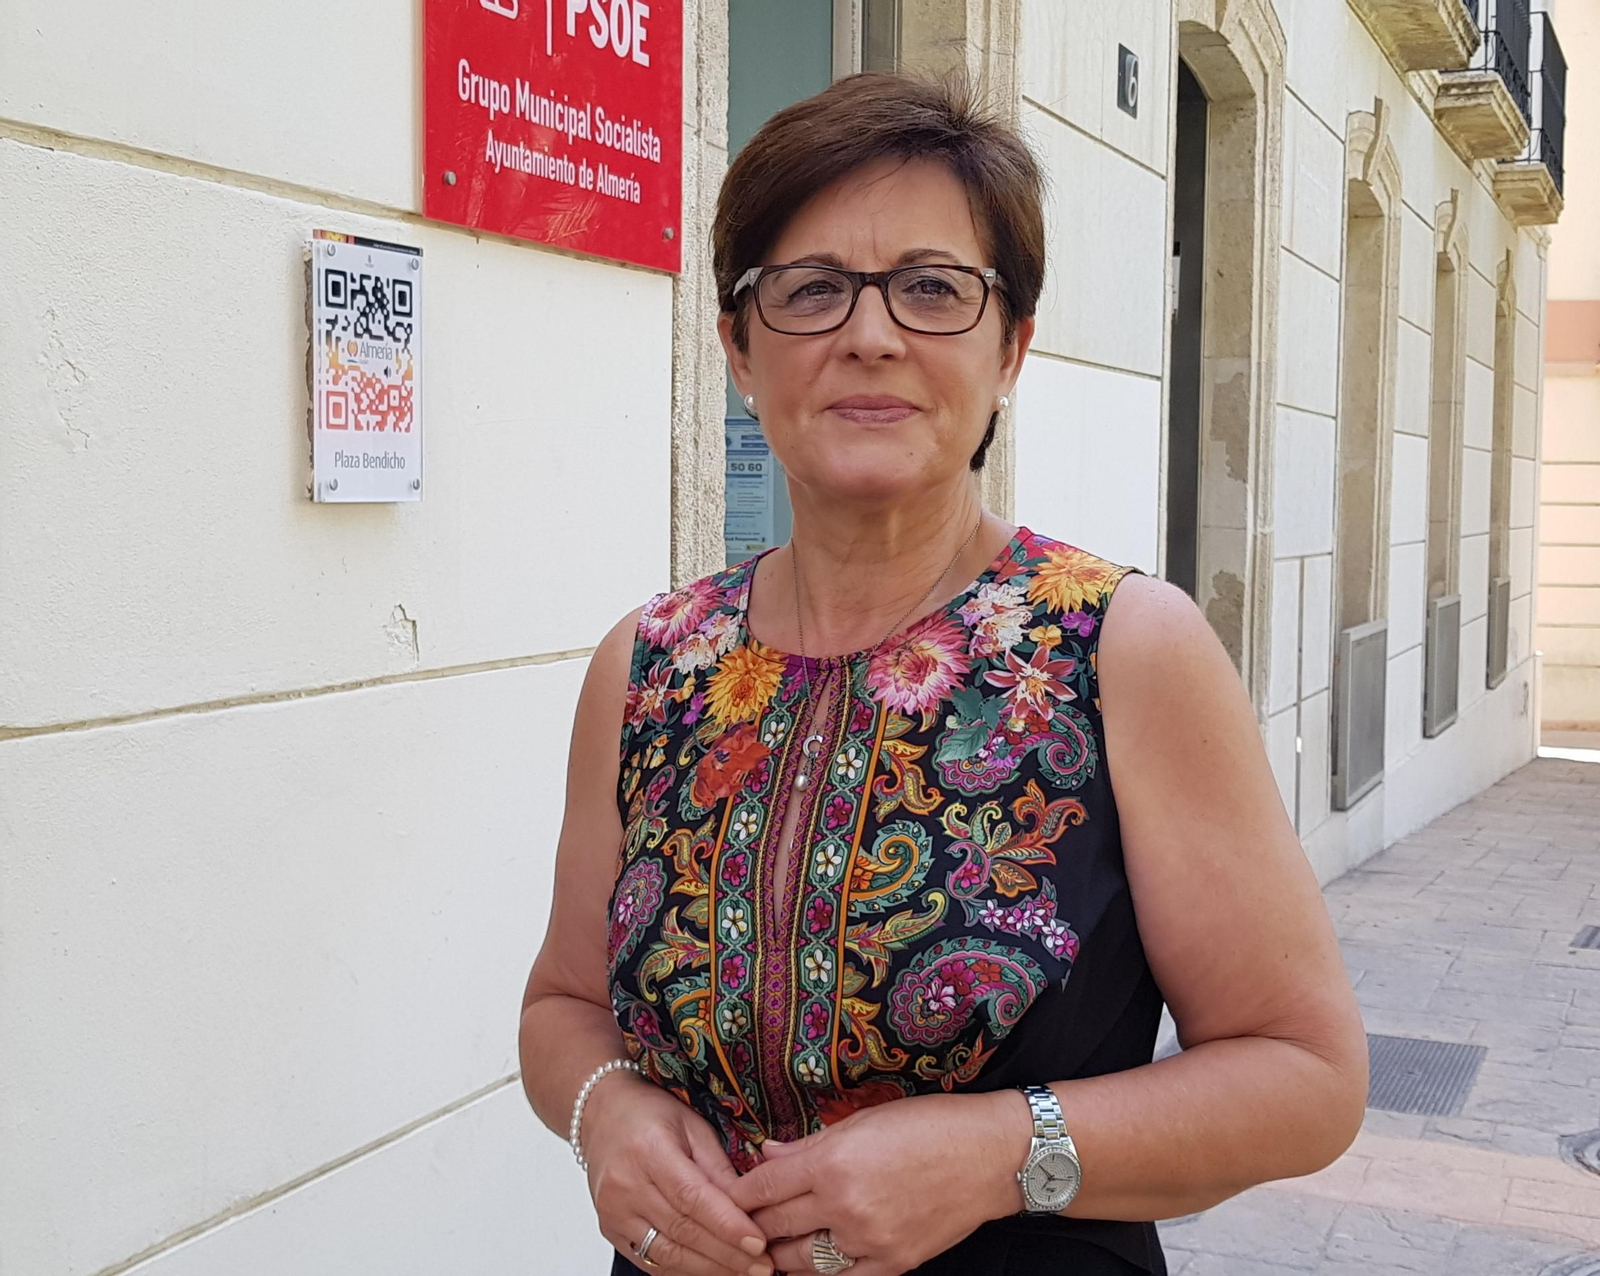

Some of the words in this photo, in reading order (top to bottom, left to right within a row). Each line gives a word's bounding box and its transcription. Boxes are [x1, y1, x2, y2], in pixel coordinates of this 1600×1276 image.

[566, 0, 650, 68] PSOE
[1125, 53, 1138, 107] 6
[457, 58, 511, 121] Grupo
[515, 77, 592, 146] Municipal
[595, 106, 662, 164] Socialista
[485, 129, 576, 187] Ayuntamiento
[578, 158, 594, 191] de
[596, 162, 641, 204] Almería
[360, 341, 393, 361] Almería
[334, 449, 360, 469] Plaza
[362, 450, 406, 470] Bendicho
